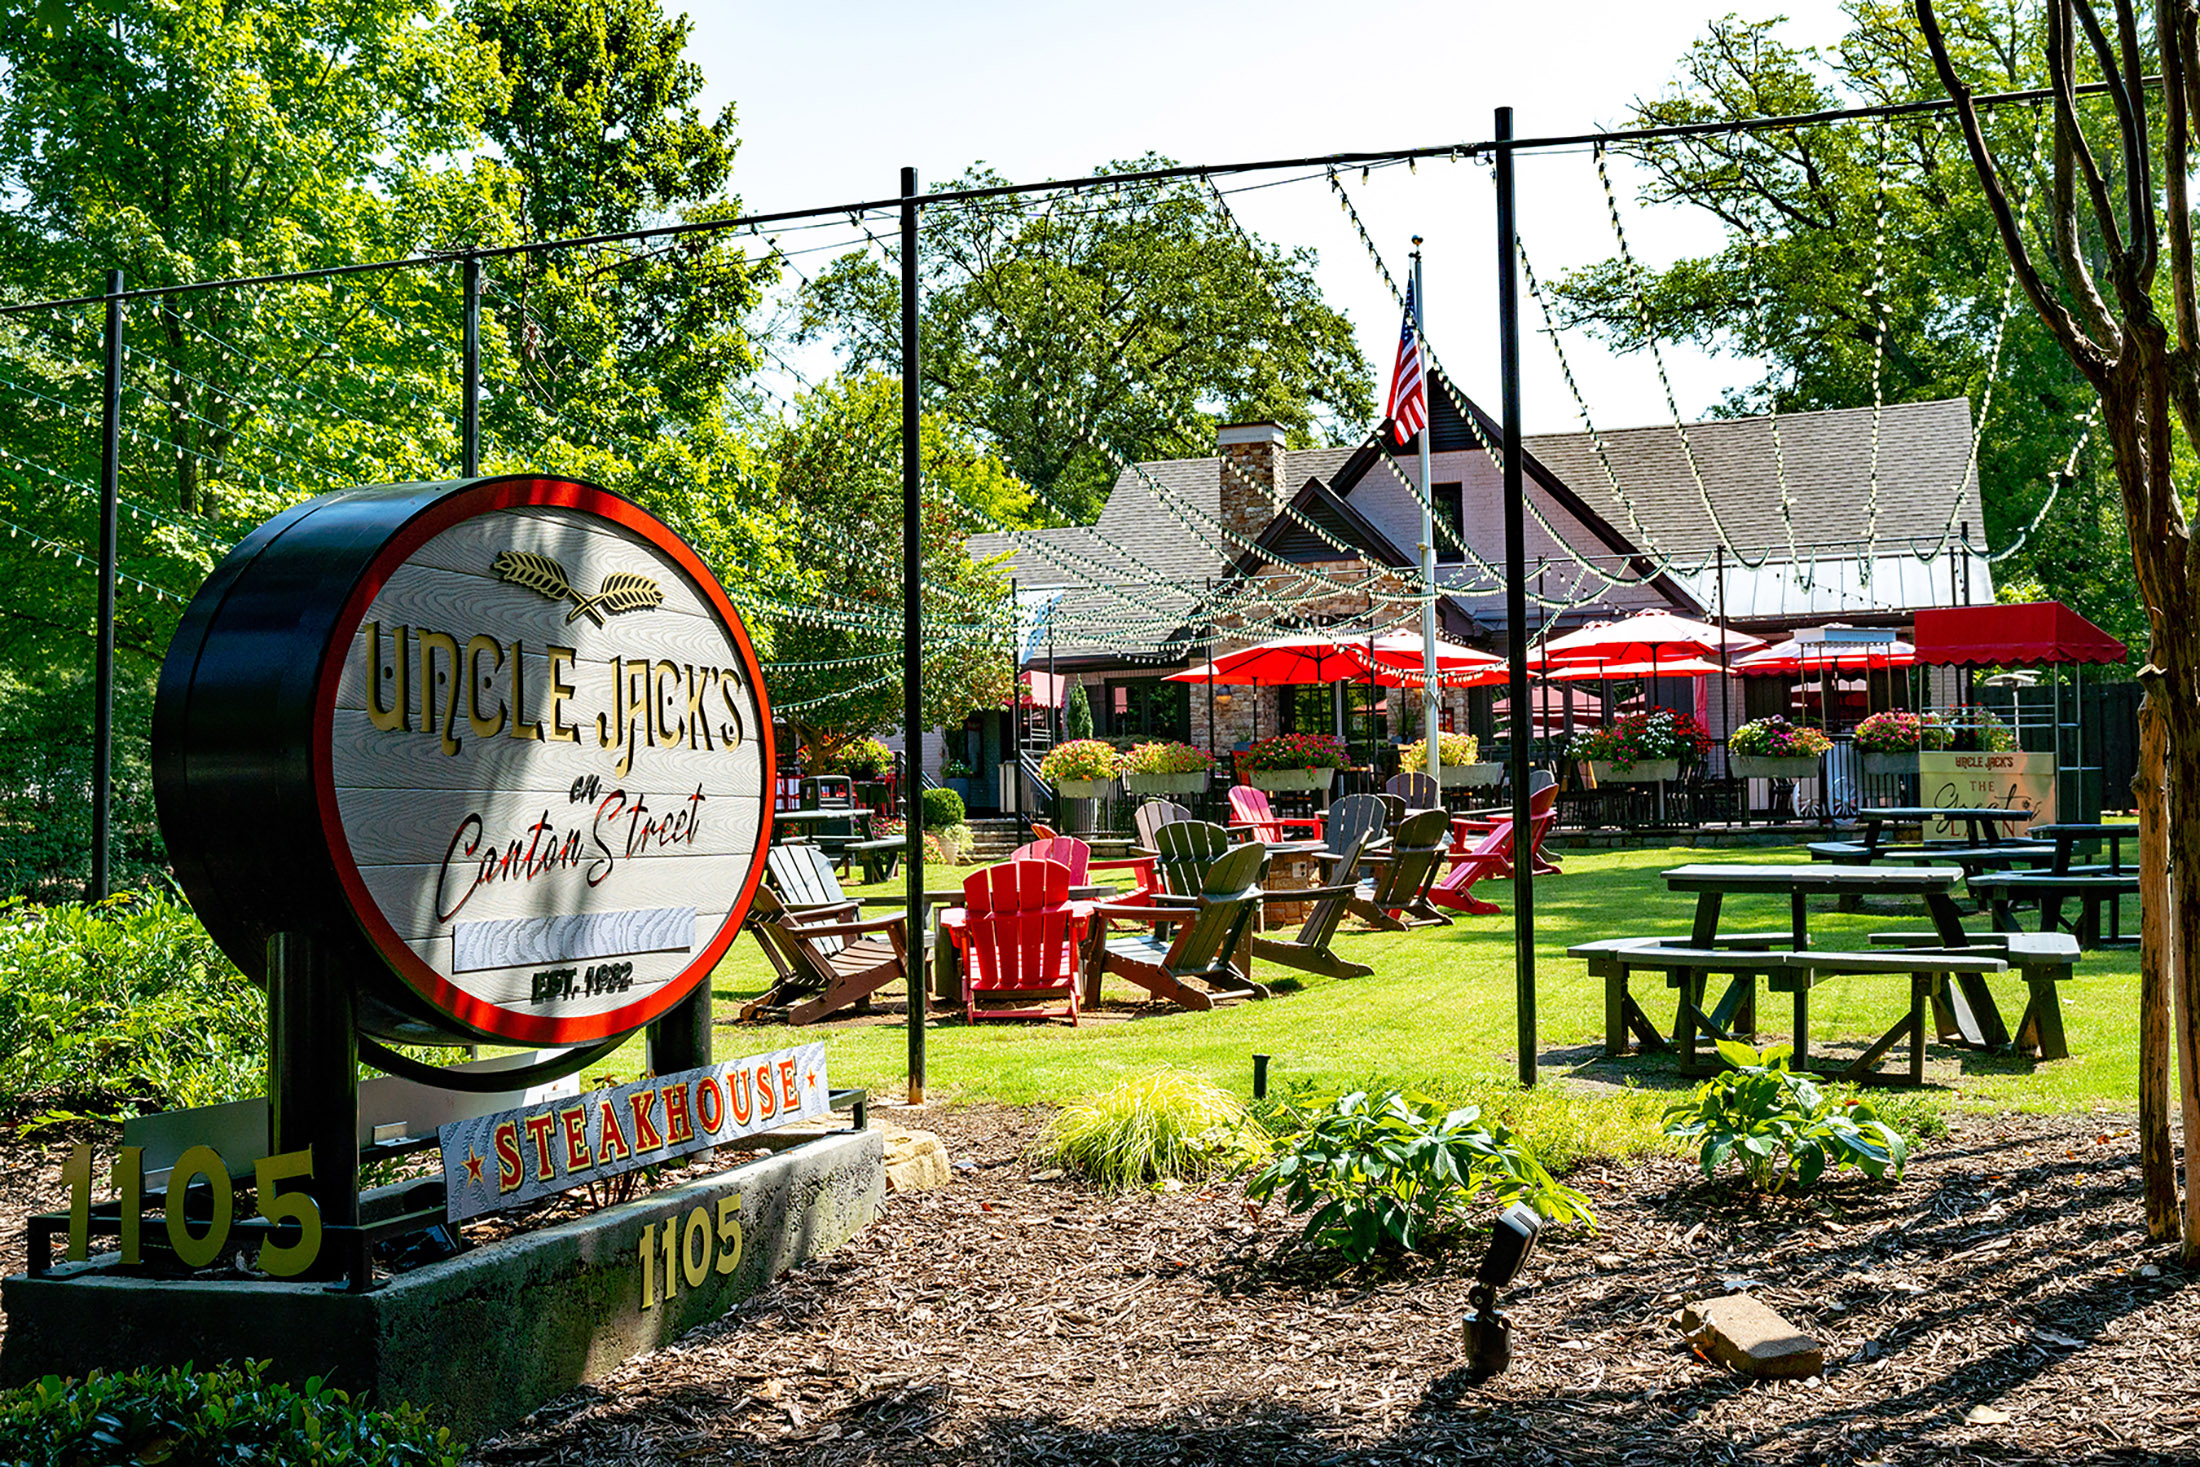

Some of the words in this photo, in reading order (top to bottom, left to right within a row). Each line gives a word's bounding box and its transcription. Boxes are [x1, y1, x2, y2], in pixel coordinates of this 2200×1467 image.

[364, 620, 582, 757] UNCLE
[595, 653, 742, 780] JACK'S
[436, 809, 584, 923] Canton
[587, 783, 706, 888] Street
[1969, 780, 1995, 792] THE
[531, 967, 580, 1005] EST.
[494, 1055, 801, 1194] STEAKHOUSE
[62, 1143, 323, 1277] 1105
[639, 1193, 743, 1310] 1105
